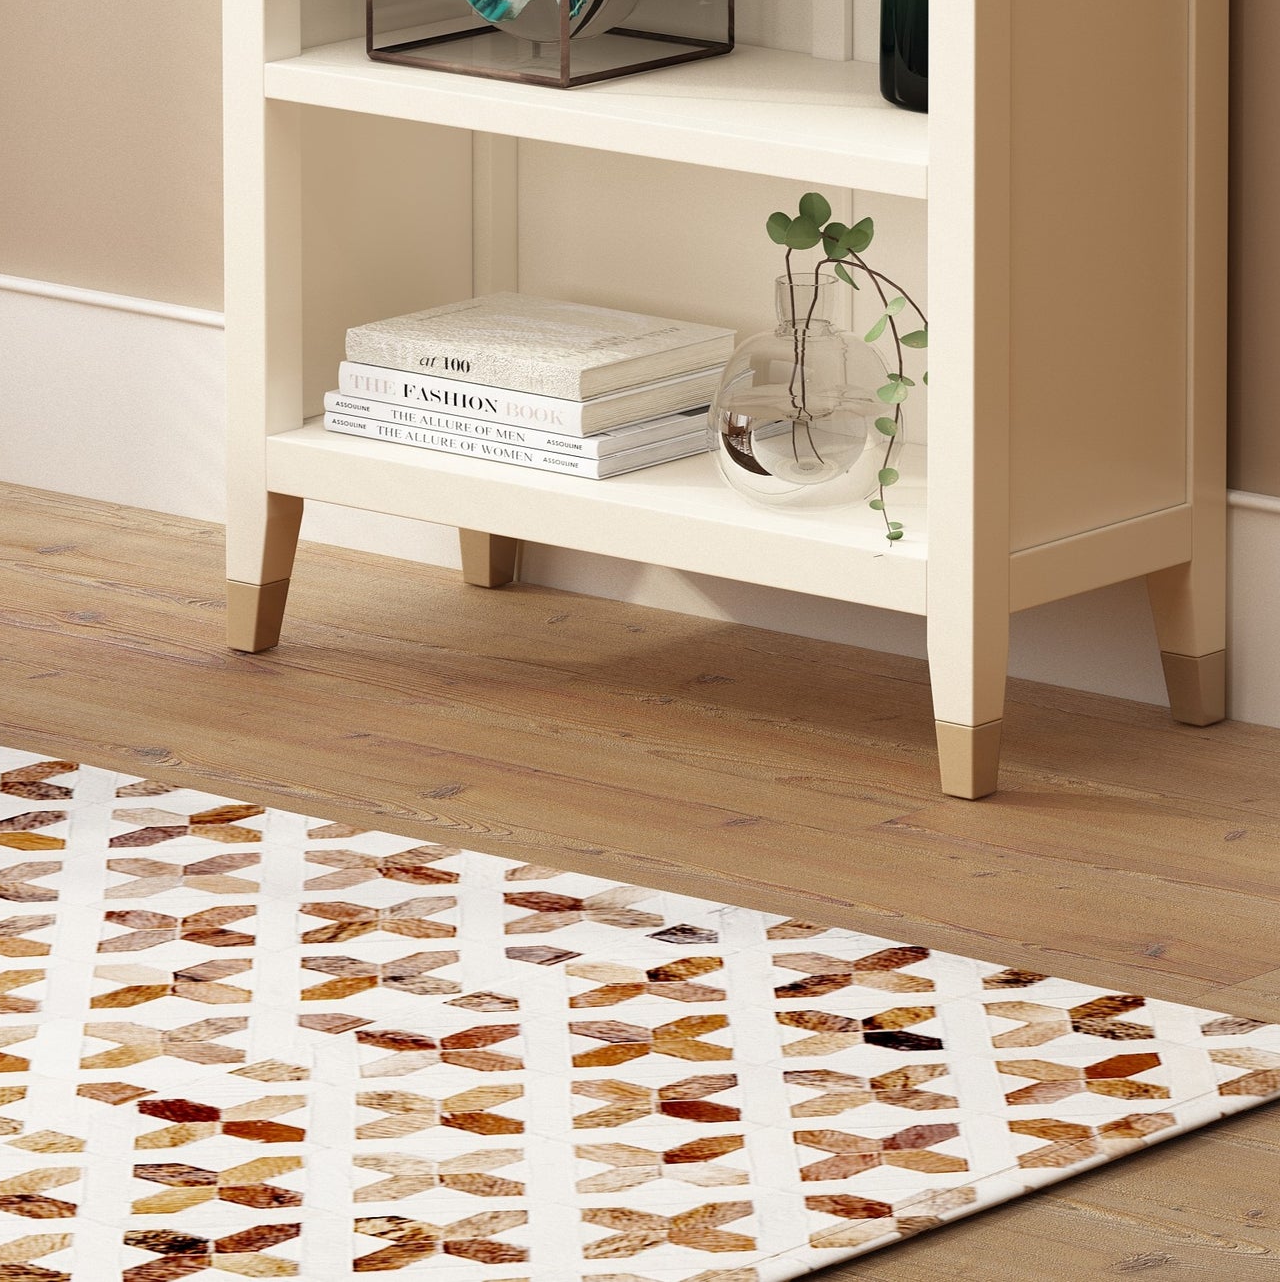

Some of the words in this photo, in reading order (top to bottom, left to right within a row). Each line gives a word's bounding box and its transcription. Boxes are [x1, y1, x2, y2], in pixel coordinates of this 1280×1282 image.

[419, 356, 436, 367] at
[442, 357, 470, 373] 100
[335, 401, 370, 412] ASSOULINE
[350, 374, 396, 396] THE
[404, 384, 498, 413] FASHION
[506, 402, 564, 426] BOOK
[332, 418, 367, 430] ASSOULINE
[391, 409, 417, 423] THE
[419, 415, 472, 433] ALLURE
[475, 425, 493, 436] OF
[496, 428, 525, 442] MEN
[376, 425, 402, 438] THE
[405, 431, 457, 448] ALLURE
[460, 439, 478, 451] OF
[481, 445, 533, 462] WOMEN
[546, 439, 583, 450] ASSOULINE
[543, 457, 579, 468] ASSOULINE
